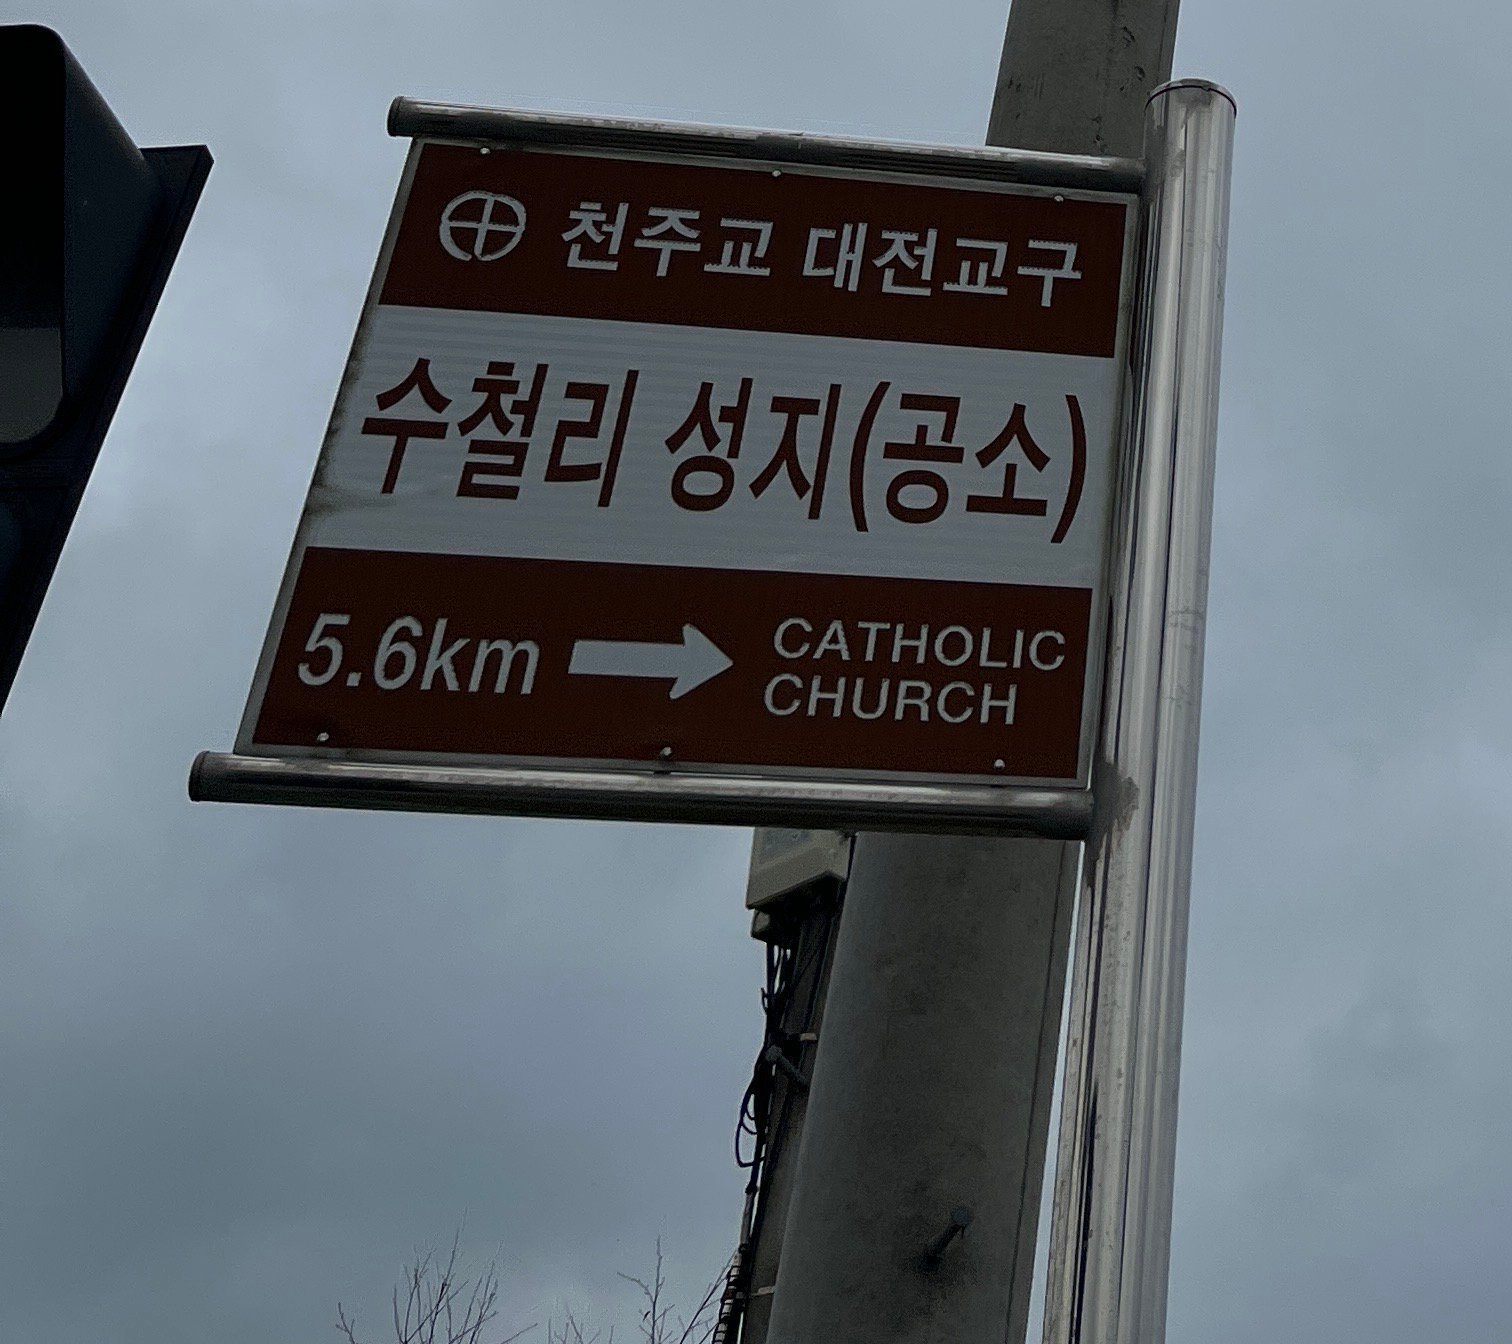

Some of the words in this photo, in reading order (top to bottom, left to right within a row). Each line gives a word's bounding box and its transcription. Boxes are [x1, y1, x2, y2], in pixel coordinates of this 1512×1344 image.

[561, 199, 771, 279] 천주교
[802, 221, 1084, 308] 대전교구
[361, 356, 640, 508] 수철리
[664, 376, 1088, 544] 성지(공소)
[297, 611, 541, 697] 5.6km
[773, 616, 1067, 672] CATHOLIC
[763, 673, 1018, 725] CHURCH
